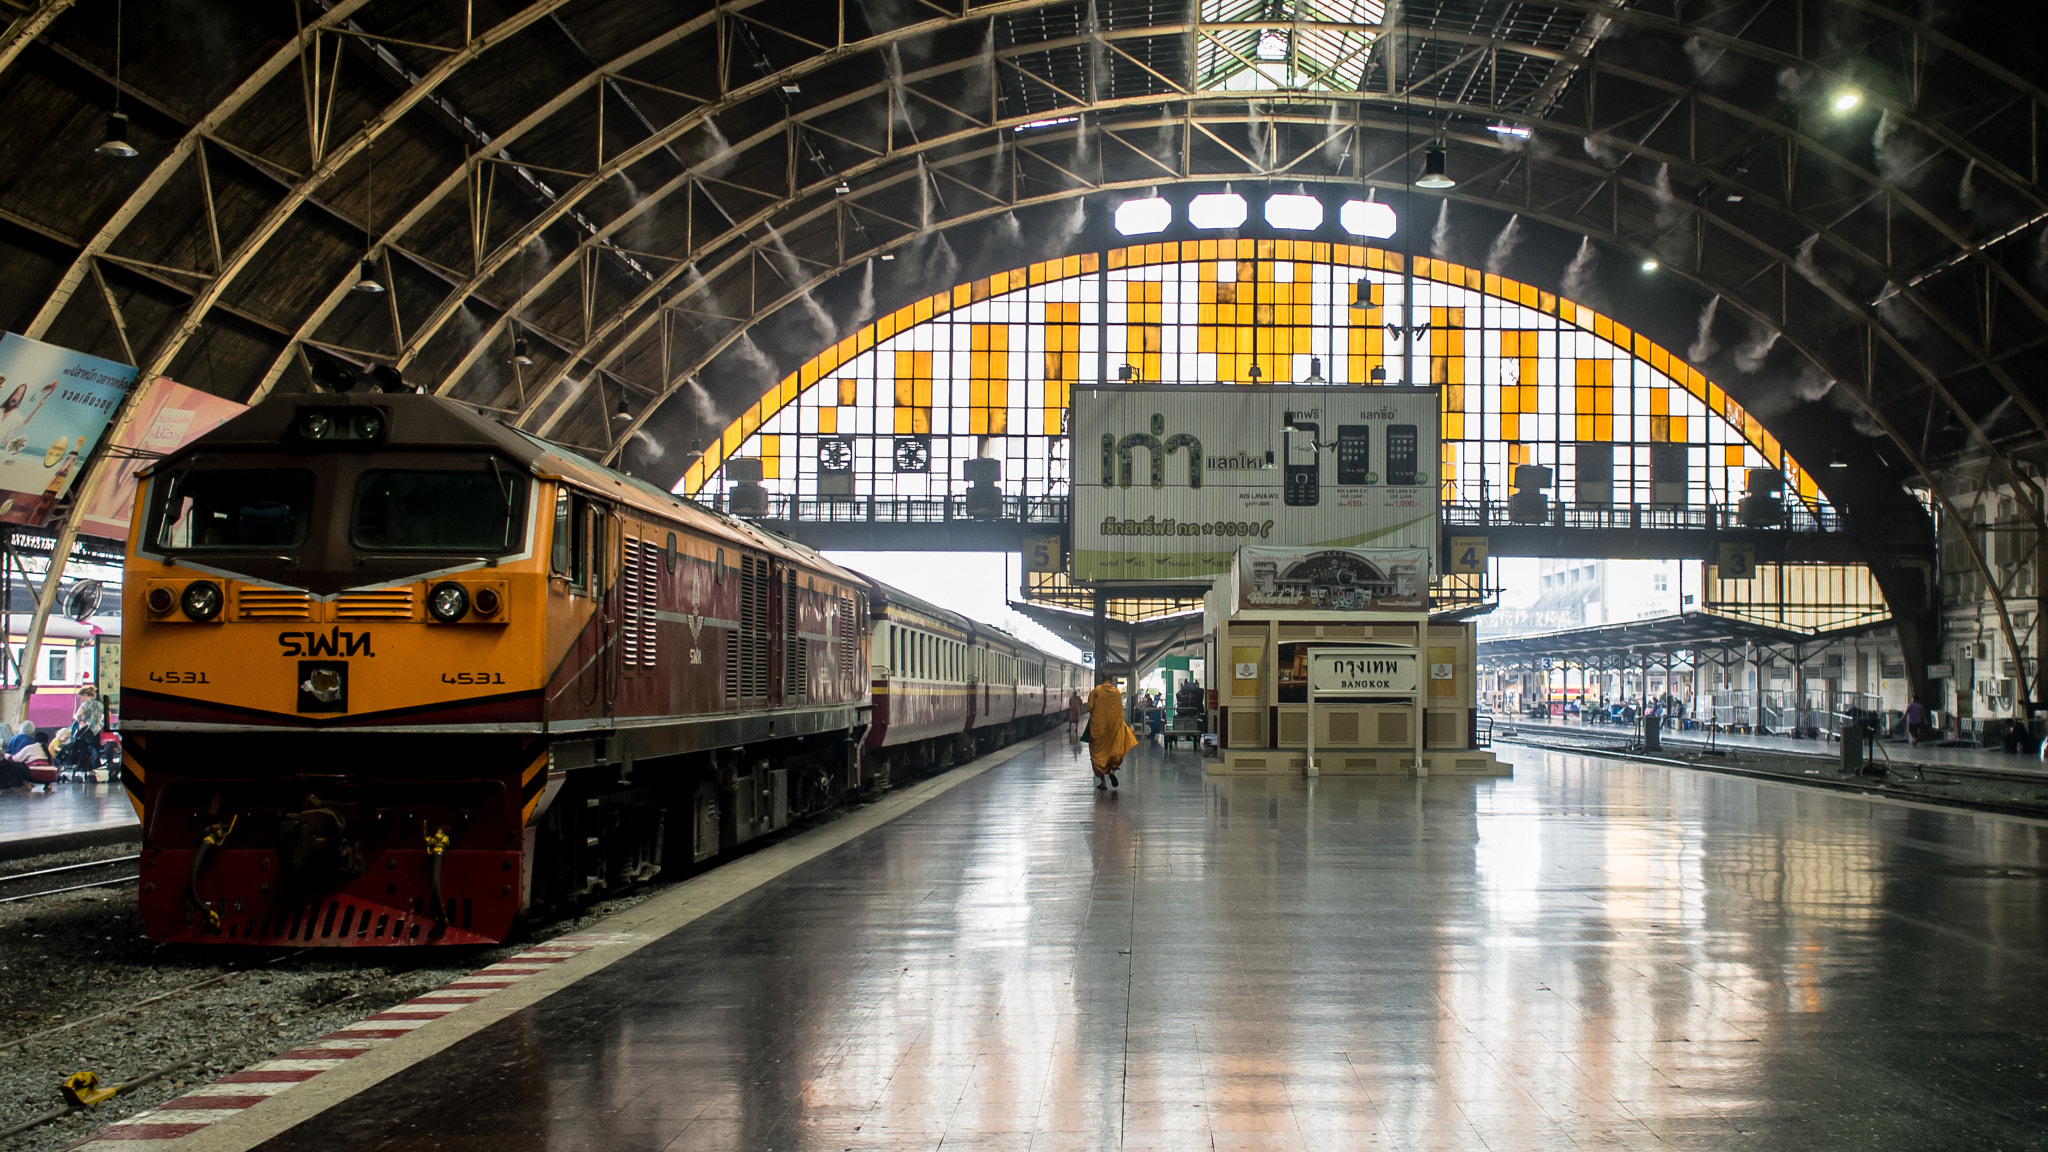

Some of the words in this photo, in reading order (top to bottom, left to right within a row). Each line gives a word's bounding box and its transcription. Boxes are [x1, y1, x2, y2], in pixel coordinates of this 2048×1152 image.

[1101, 413, 1203, 489] เก่า
[1033, 545, 1050, 568] 5
[1460, 547, 1480, 569] 4
[1729, 552, 1747, 575] 3
[278, 625, 376, 657] ร.ฟ.ท.
[1083, 652, 1092, 663] 5
[1543, 658, 1551, 669] 3
[149, 671, 211, 685] 4531
[441, 672, 506, 685] 4531
[1334, 660, 1398, 679] กรุงเทพ
[1341, 680, 1391, 689] BANGKOK
